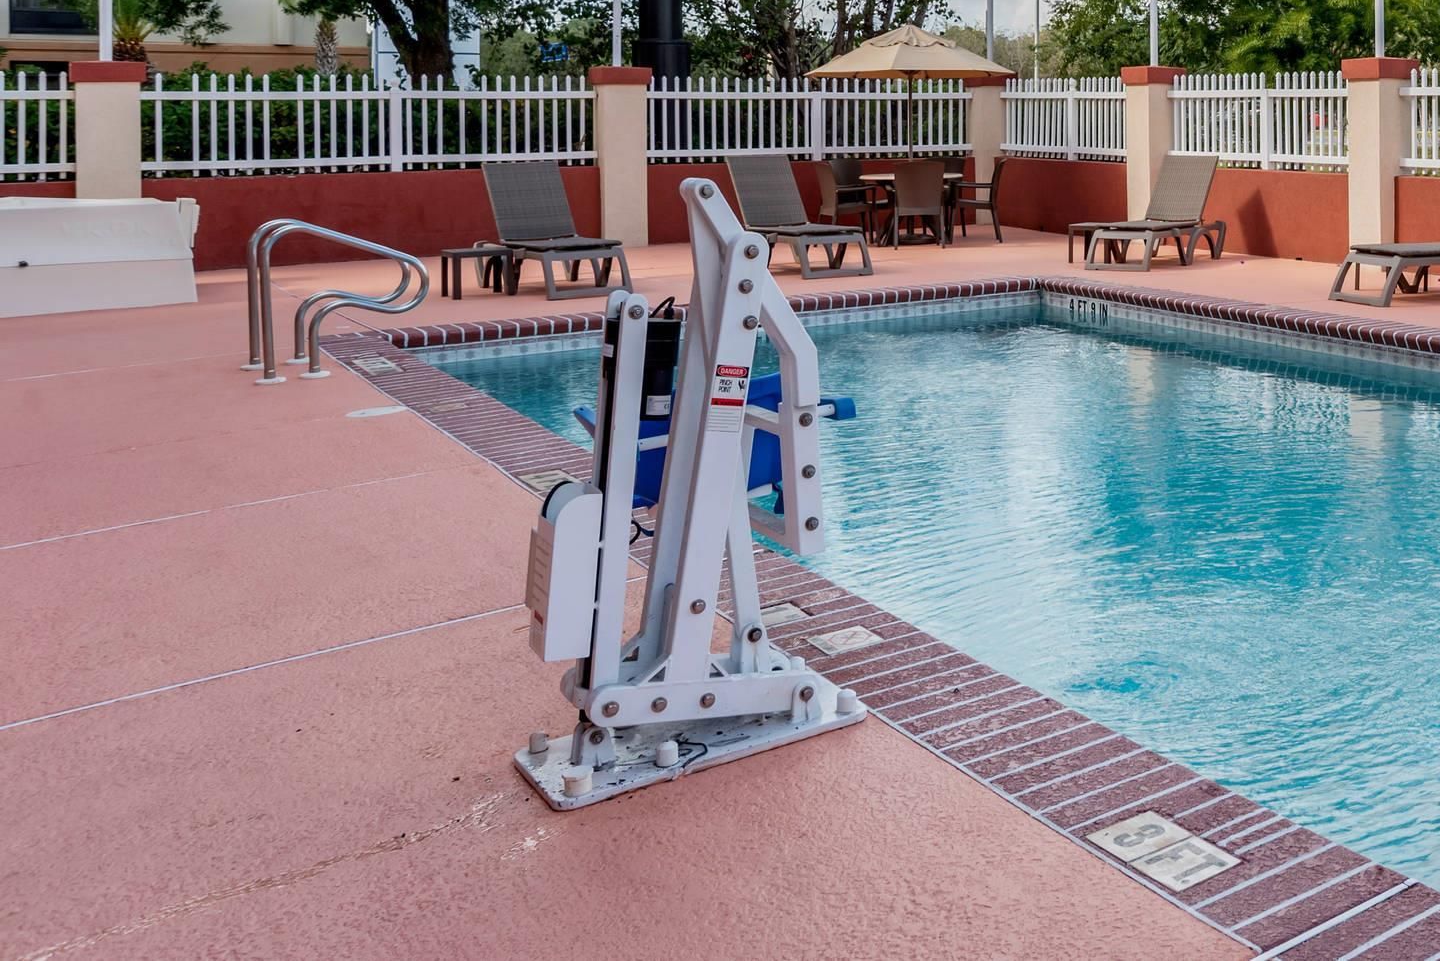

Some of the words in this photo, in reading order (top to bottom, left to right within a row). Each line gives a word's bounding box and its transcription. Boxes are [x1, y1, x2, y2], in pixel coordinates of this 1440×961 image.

[1069, 298, 1075, 311] 4
[1077, 300, 1087, 313] FT
[1090, 302, 1096, 315] 9
[1099, 303, 1108, 317] IN
[720, 367, 744, 375] DANGER
[1113, 823, 1165, 847] 3
